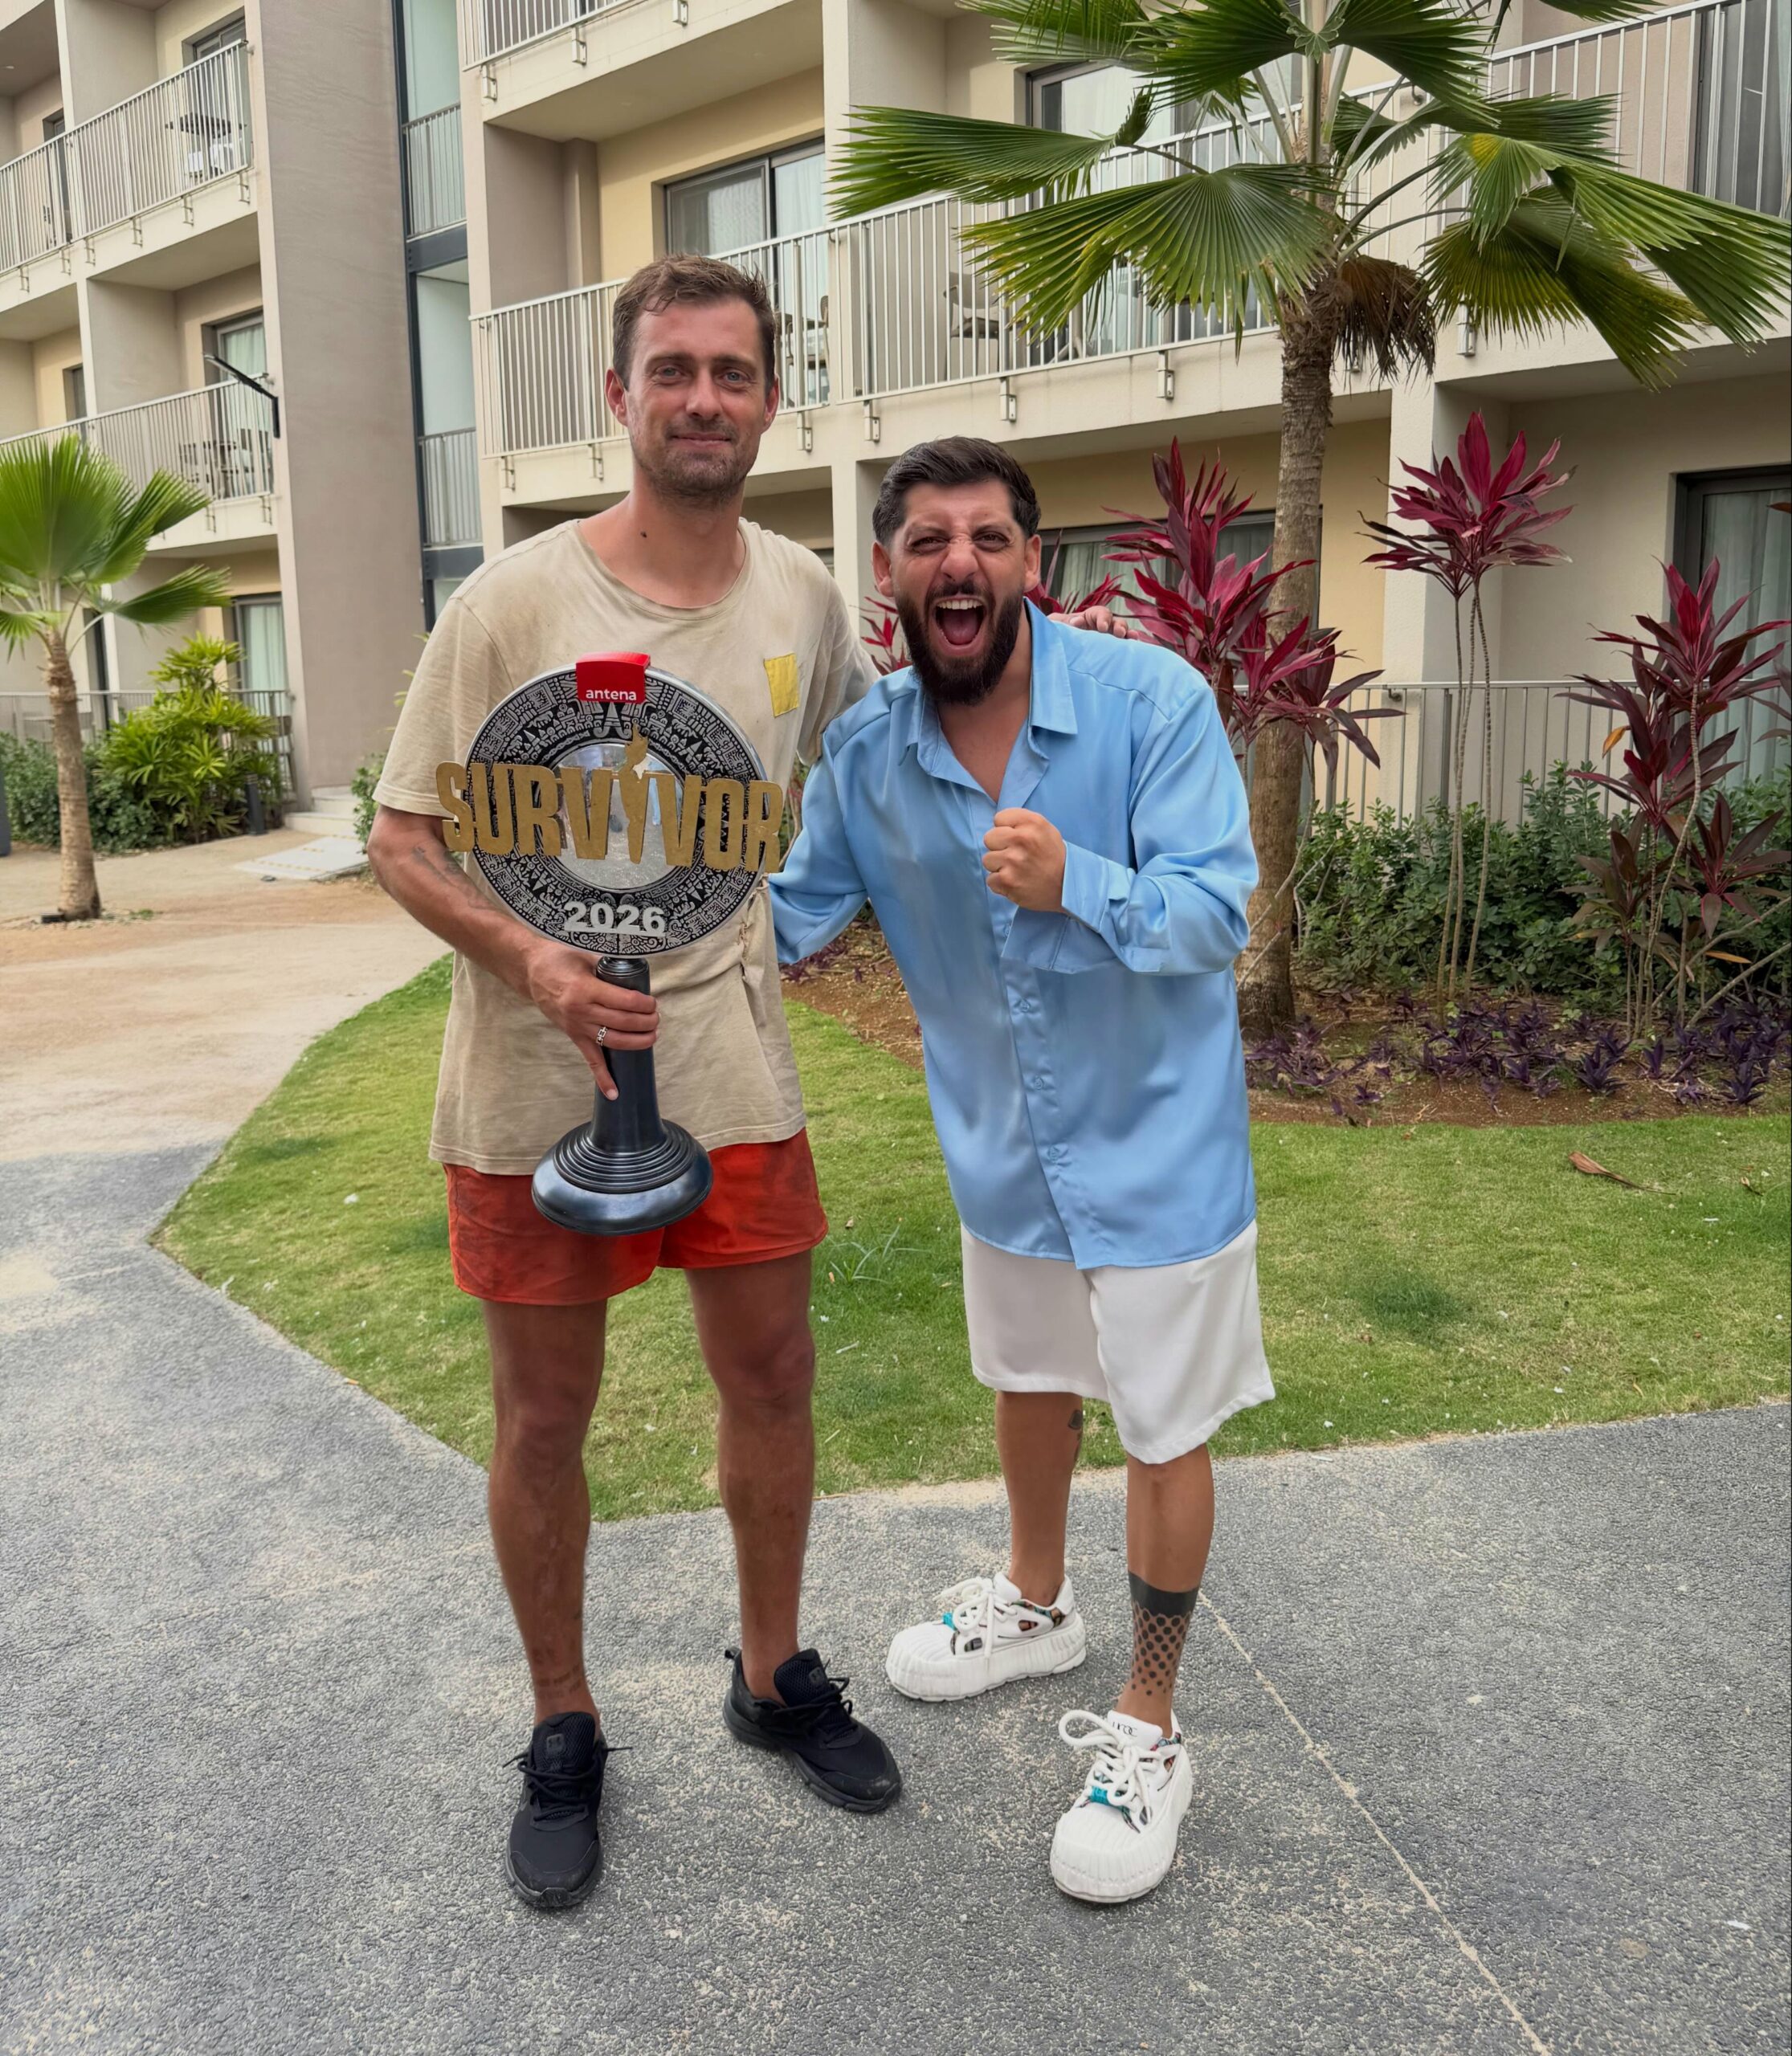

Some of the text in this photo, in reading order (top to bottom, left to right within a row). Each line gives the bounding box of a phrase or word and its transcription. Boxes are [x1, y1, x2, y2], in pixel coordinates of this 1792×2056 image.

[586, 688, 637, 701] antena
[435, 759, 784, 873] SURVIVOR
[563, 901, 666, 936] 2026
